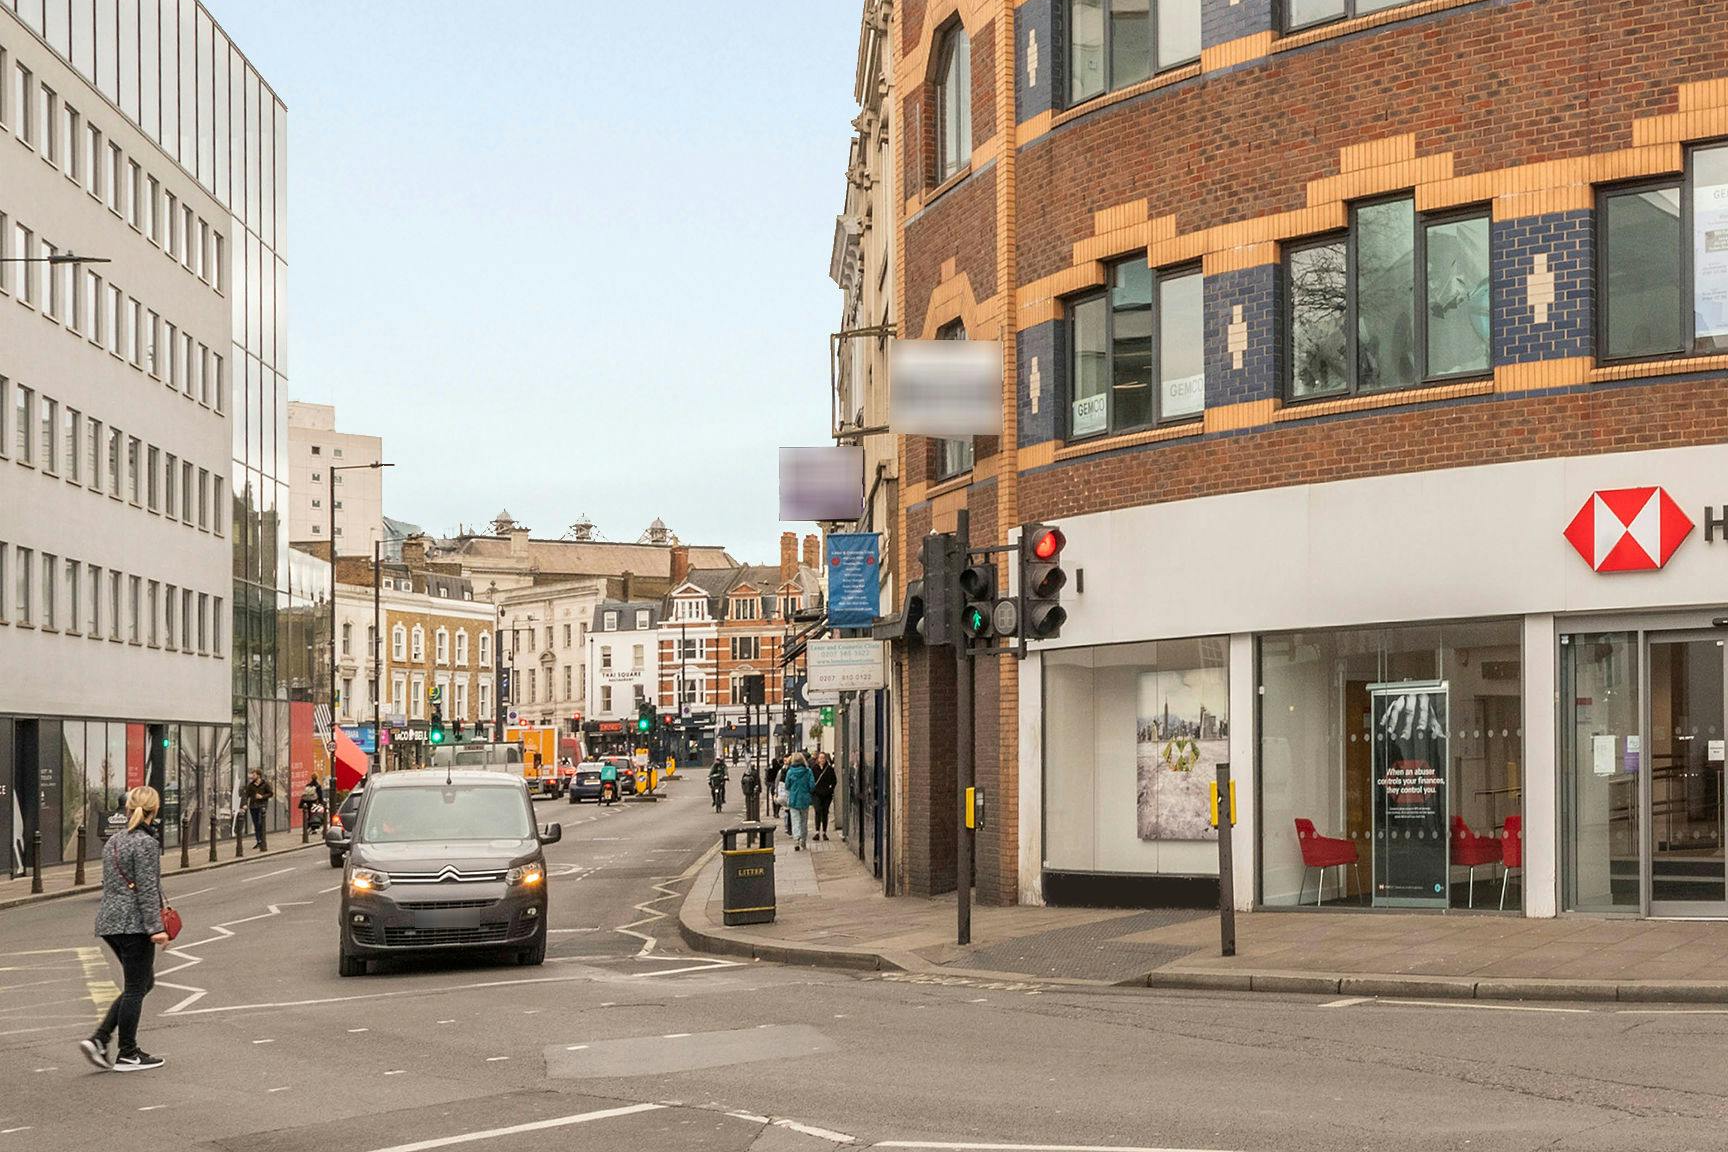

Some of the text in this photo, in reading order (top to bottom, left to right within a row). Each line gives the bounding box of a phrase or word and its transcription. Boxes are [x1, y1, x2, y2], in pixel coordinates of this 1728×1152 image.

[1169, 376, 1204, 397] GEMCO
[1077, 398, 1105, 417] GEMCO
[1386, 768, 1404, 776] When
[1414, 767, 1435, 776] abuser
[1403, 778, 1416, 787] your
[1400, 786, 1423, 794] control
[738, 868, 765, 877] LITTER
